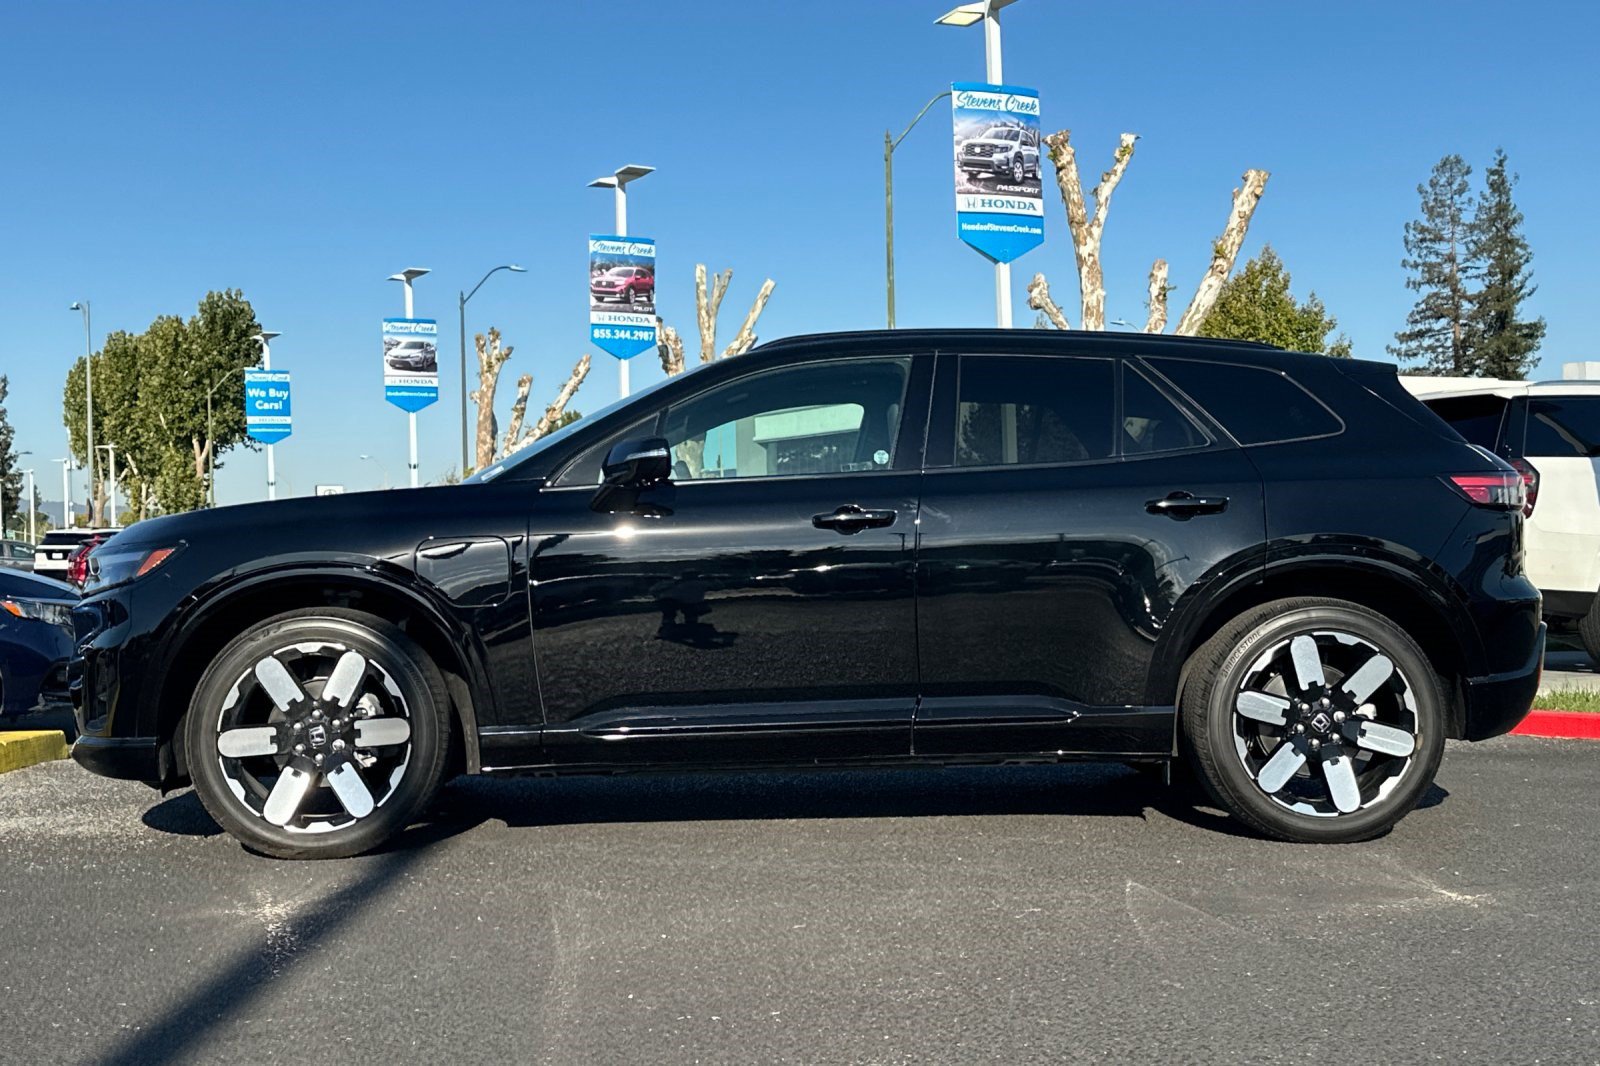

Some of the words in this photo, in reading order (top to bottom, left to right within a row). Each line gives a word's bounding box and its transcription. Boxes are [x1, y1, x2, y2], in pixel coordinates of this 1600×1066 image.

[956, 91, 1002, 110] Stevens
[1005, 94, 1038, 113] Creek
[996, 184, 1040, 194] PASSPORT
[980, 199, 1037, 211] HONDA
[608, 315, 650, 323] HONDA
[593, 328, 654, 341] 855.344.2987
[248, 388, 267, 398] We
[269, 388, 289, 400] Buy
[255, 400, 283, 410] Cars!
